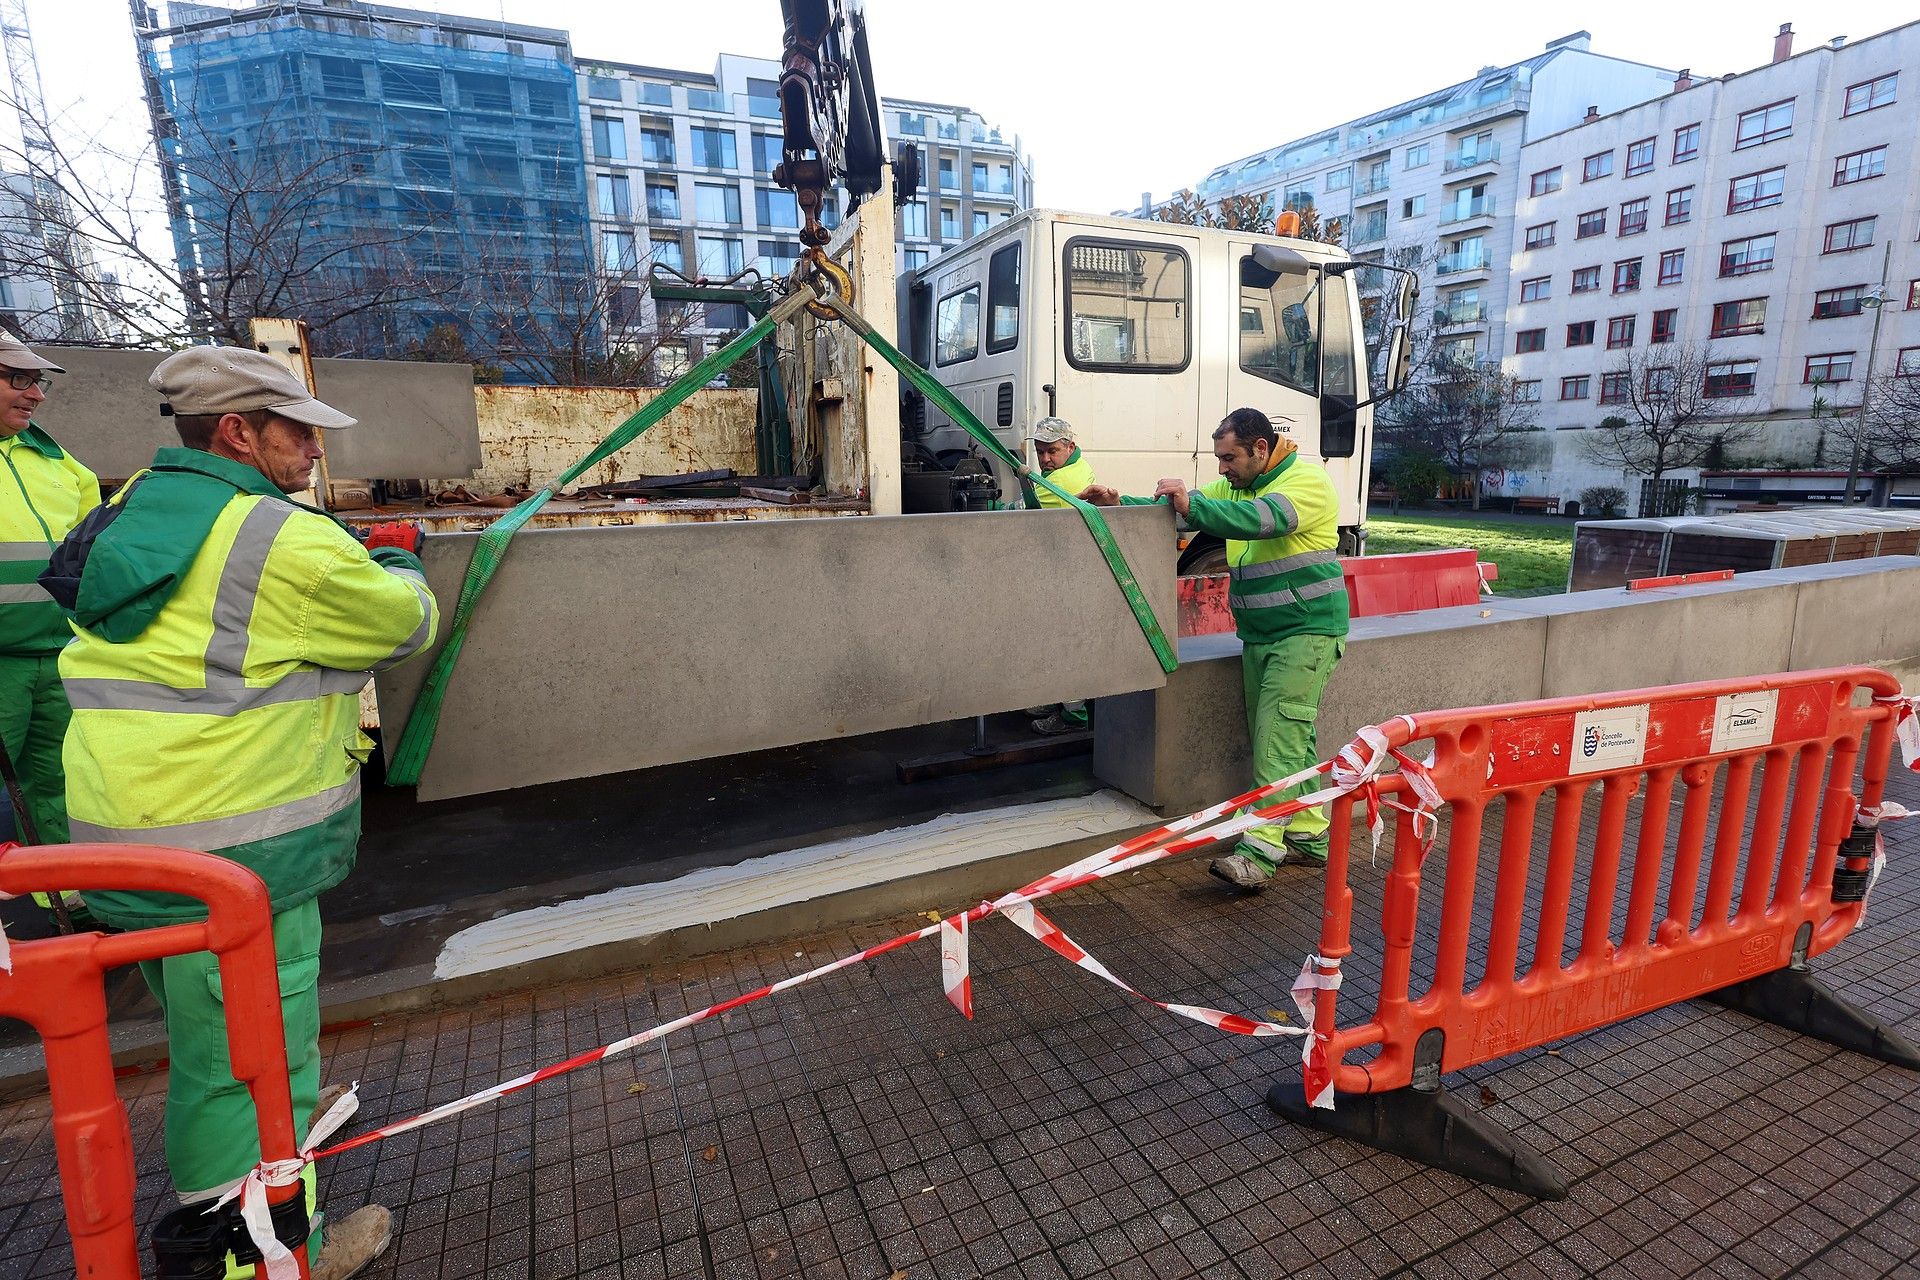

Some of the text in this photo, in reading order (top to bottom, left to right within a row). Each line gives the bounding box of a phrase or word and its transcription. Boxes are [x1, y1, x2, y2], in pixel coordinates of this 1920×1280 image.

[1733, 718, 1758, 727] ELSAMEX
[1601, 732, 1623, 741] Concello
[1607, 738, 1636, 747] Pontevedra
